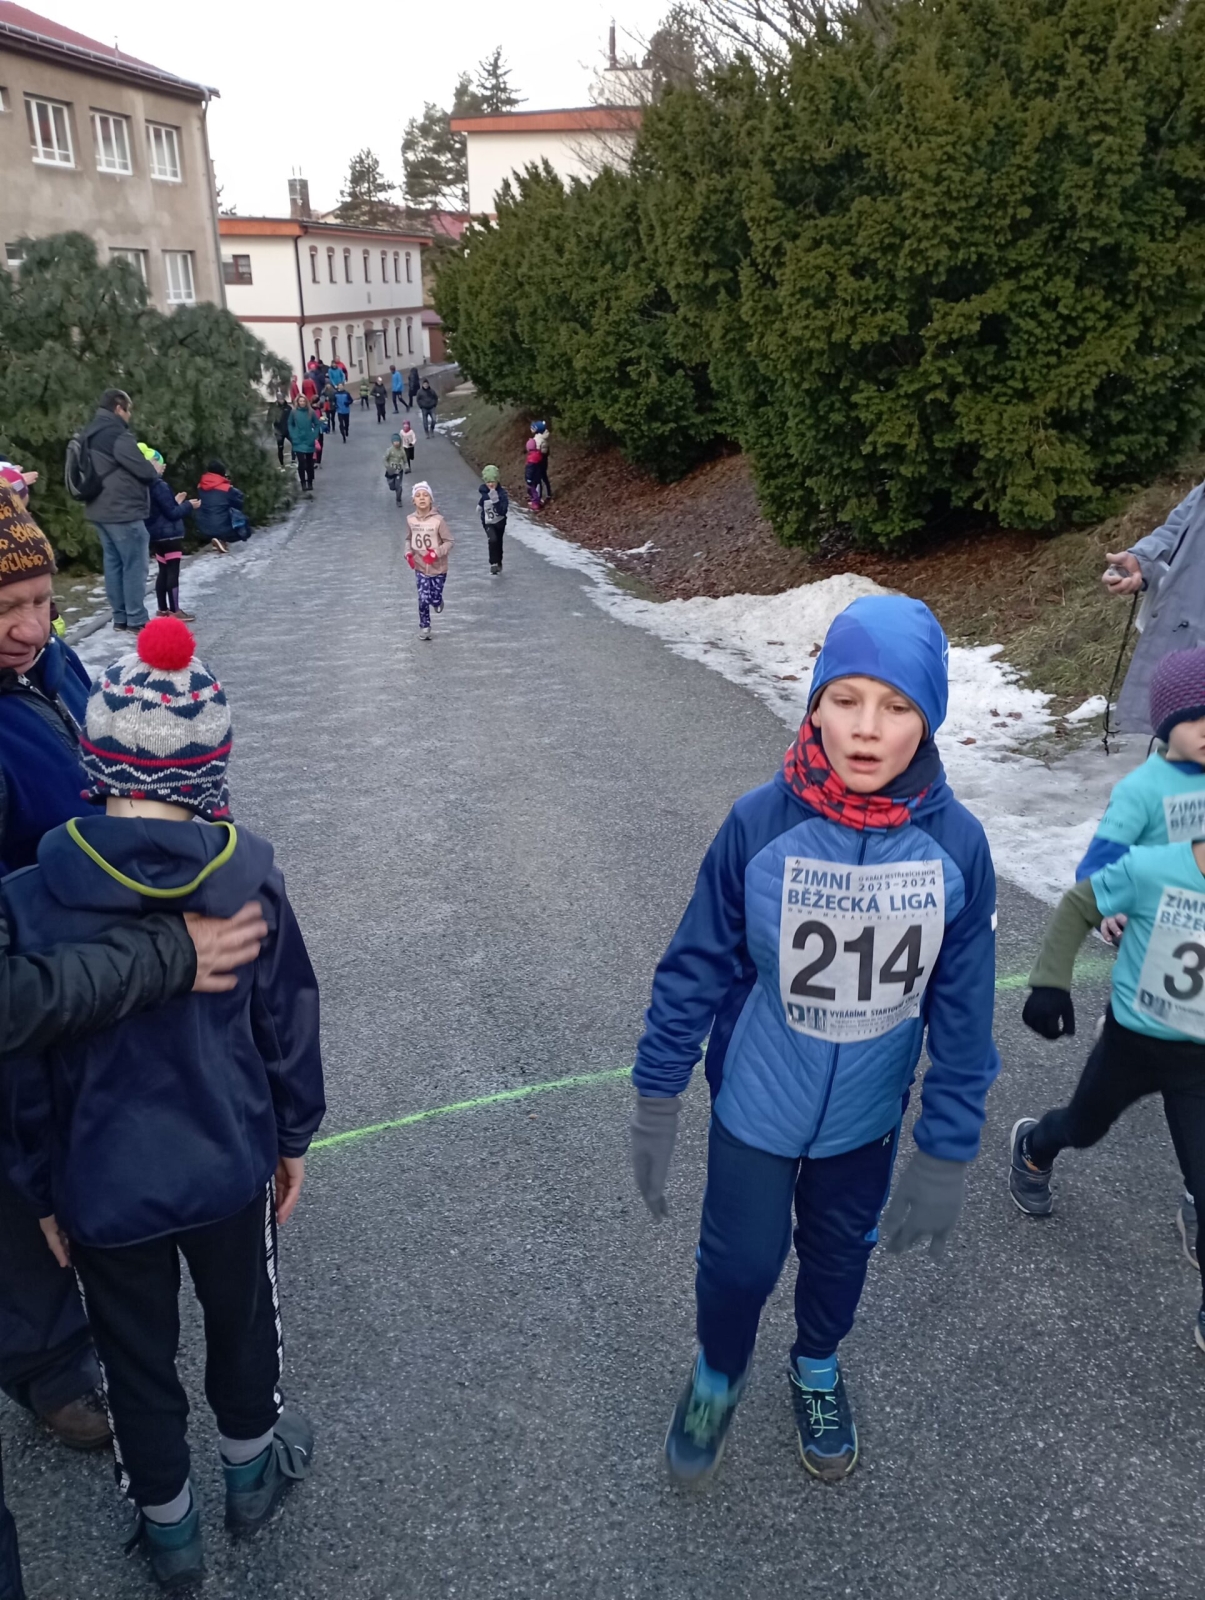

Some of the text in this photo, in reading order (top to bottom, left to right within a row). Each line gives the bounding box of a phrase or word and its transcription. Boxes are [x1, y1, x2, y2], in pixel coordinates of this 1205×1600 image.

[415, 533, 432, 549] 66
[790, 867, 852, 891] ZIMNÍ
[787, 887, 938, 913] BĚŽECKÁ LIGA
[790, 919, 925, 1001] 214
